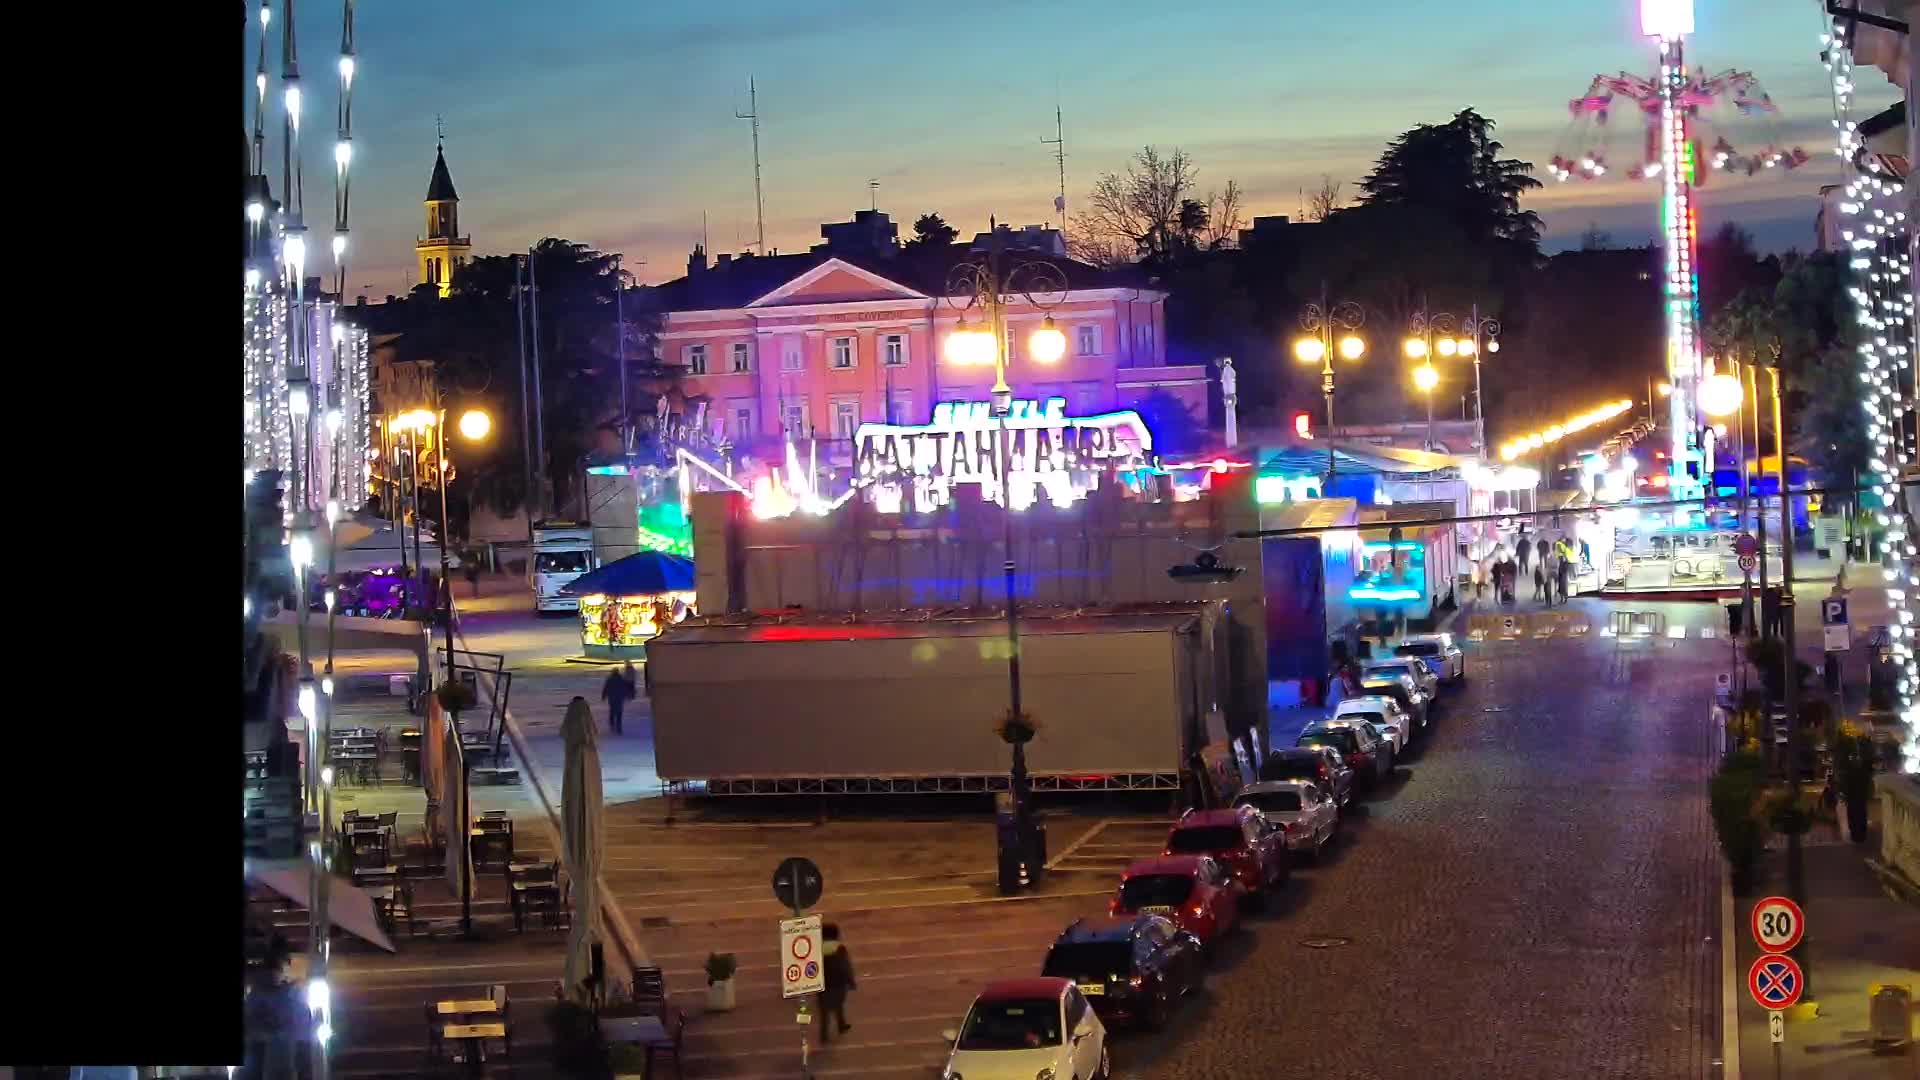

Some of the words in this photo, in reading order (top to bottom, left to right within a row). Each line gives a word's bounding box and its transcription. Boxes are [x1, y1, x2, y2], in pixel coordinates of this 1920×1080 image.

[1742, 558, 1753, 567] 20
[1826, 602, 1842, 622] P
[1762, 911, 1792, 938] 30
